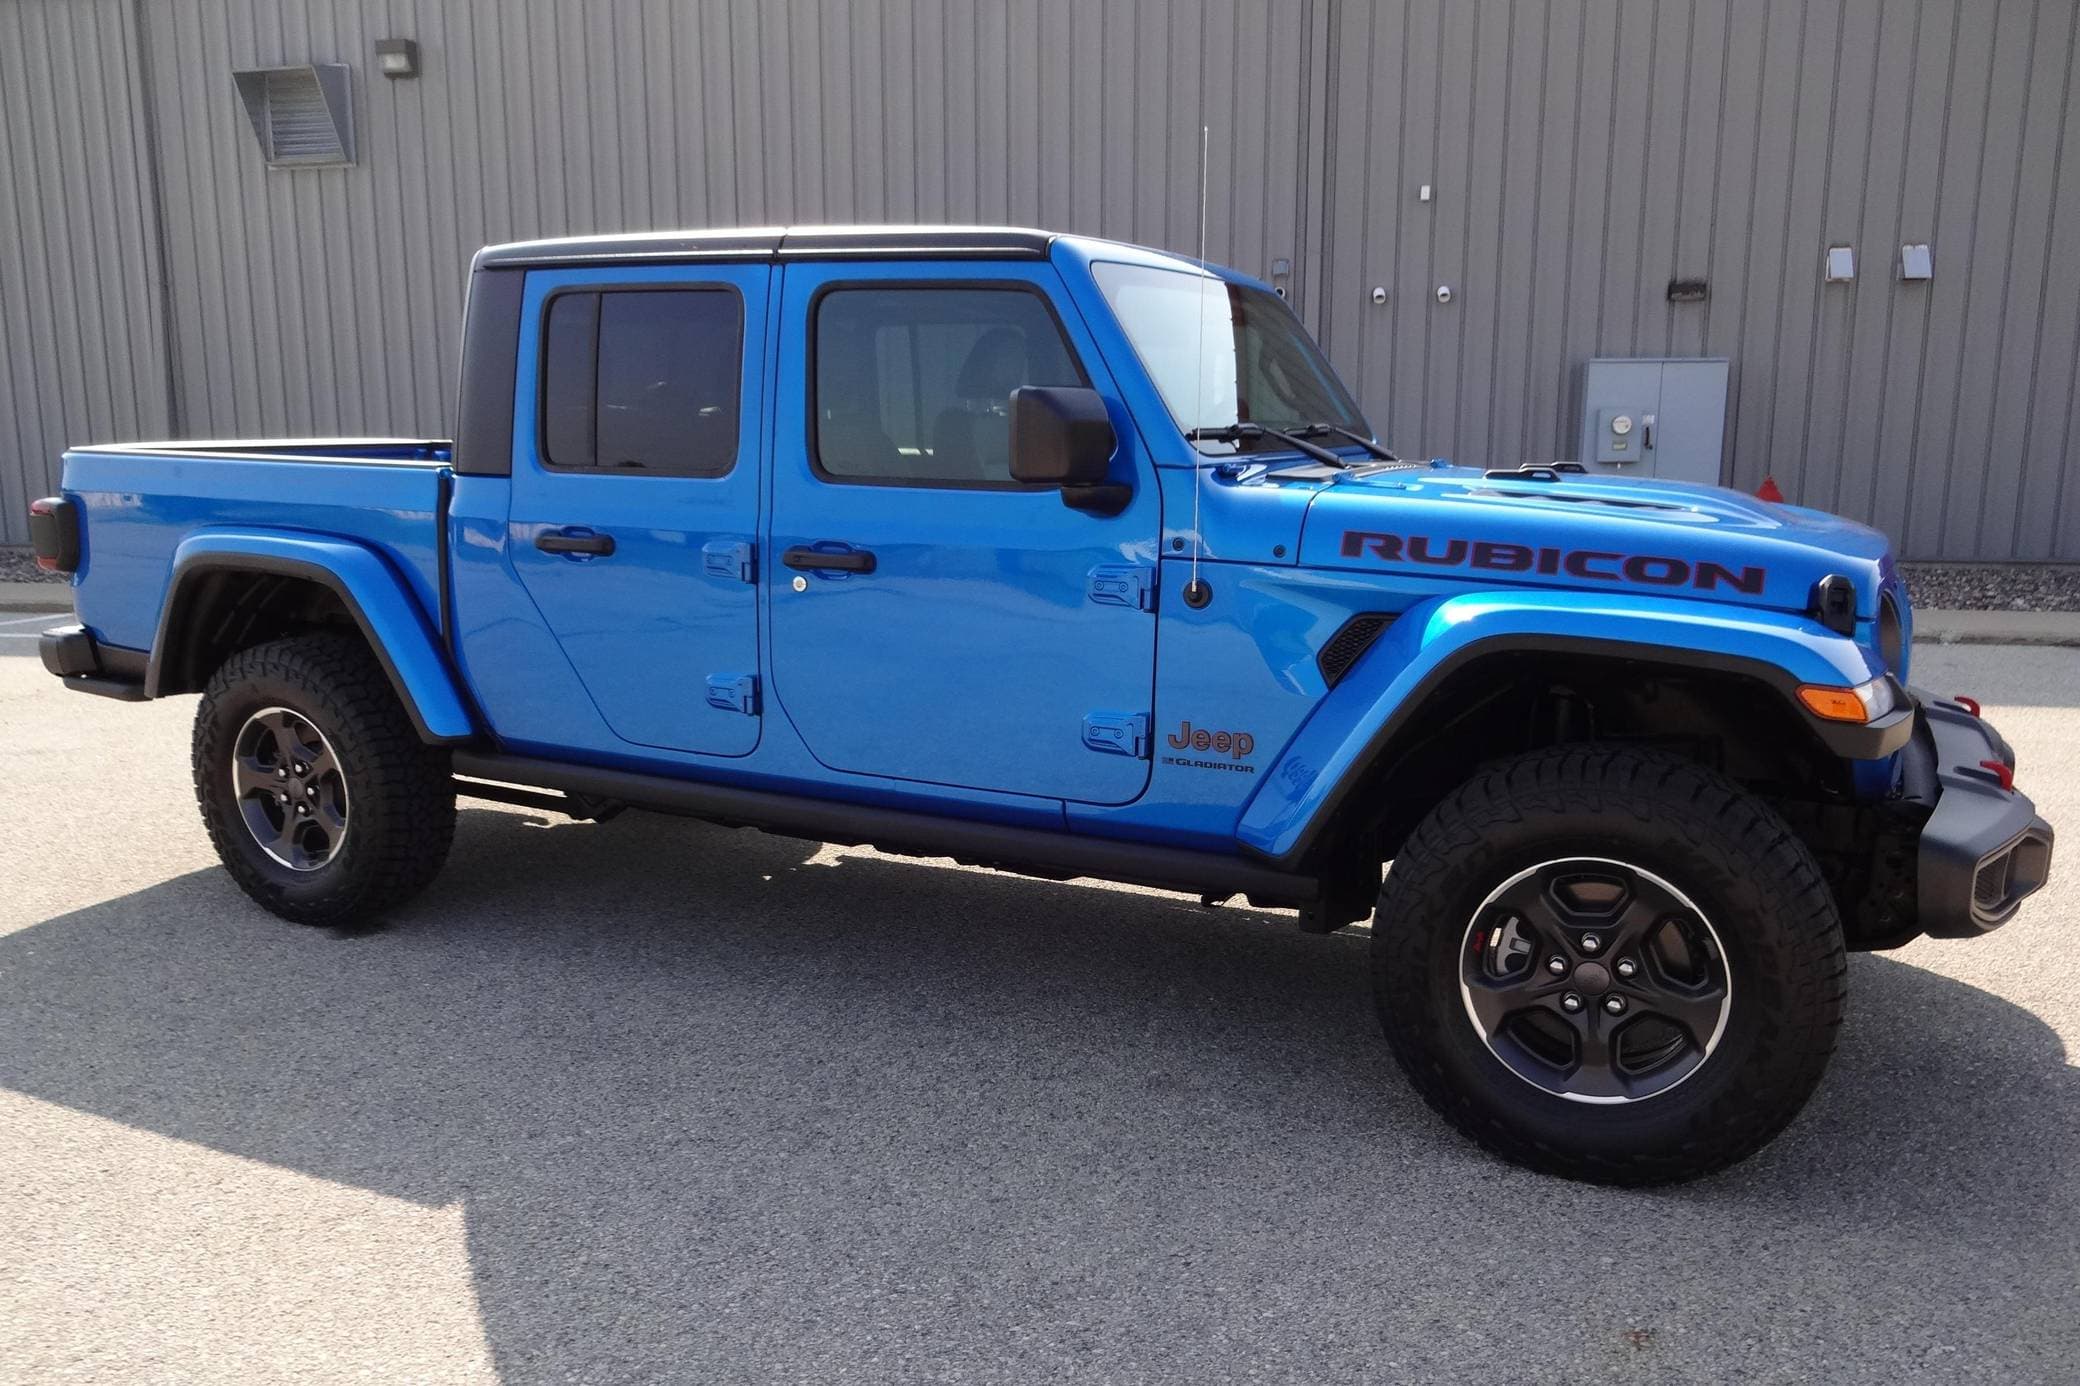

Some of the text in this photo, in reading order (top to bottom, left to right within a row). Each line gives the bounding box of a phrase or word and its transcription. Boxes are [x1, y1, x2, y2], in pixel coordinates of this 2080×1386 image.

[1341, 530, 1766, 595] RUBICON
[1168, 721, 1254, 759] Jeep
[1175, 758, 1255, 774] GLADIATOR
